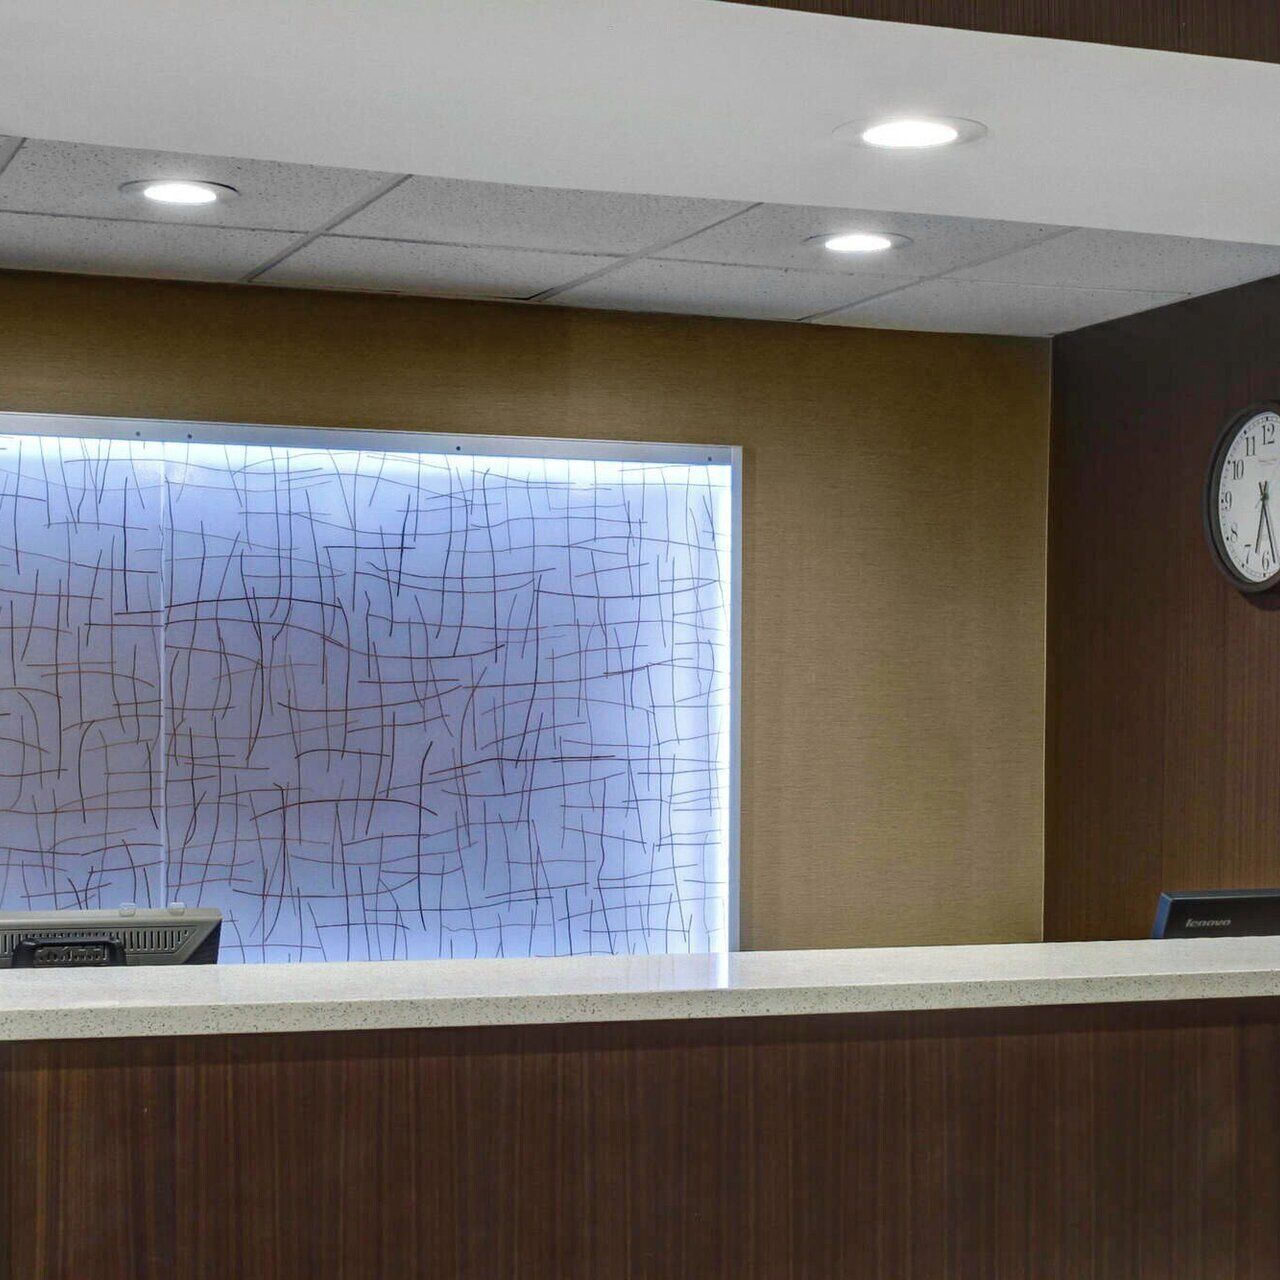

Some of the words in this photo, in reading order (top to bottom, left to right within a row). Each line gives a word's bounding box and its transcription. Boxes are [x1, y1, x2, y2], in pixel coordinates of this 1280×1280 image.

[1262, 423, 1275, 446] 12
[1245, 436, 1256, 457] 11
[1232, 459, 1245, 480] 10
[1224, 490, 1232, 511] 9
[1230, 522, 1239, 544] 8
[1244, 543, 1253, 565] 7
[1262, 551, 1270, 571] 6
